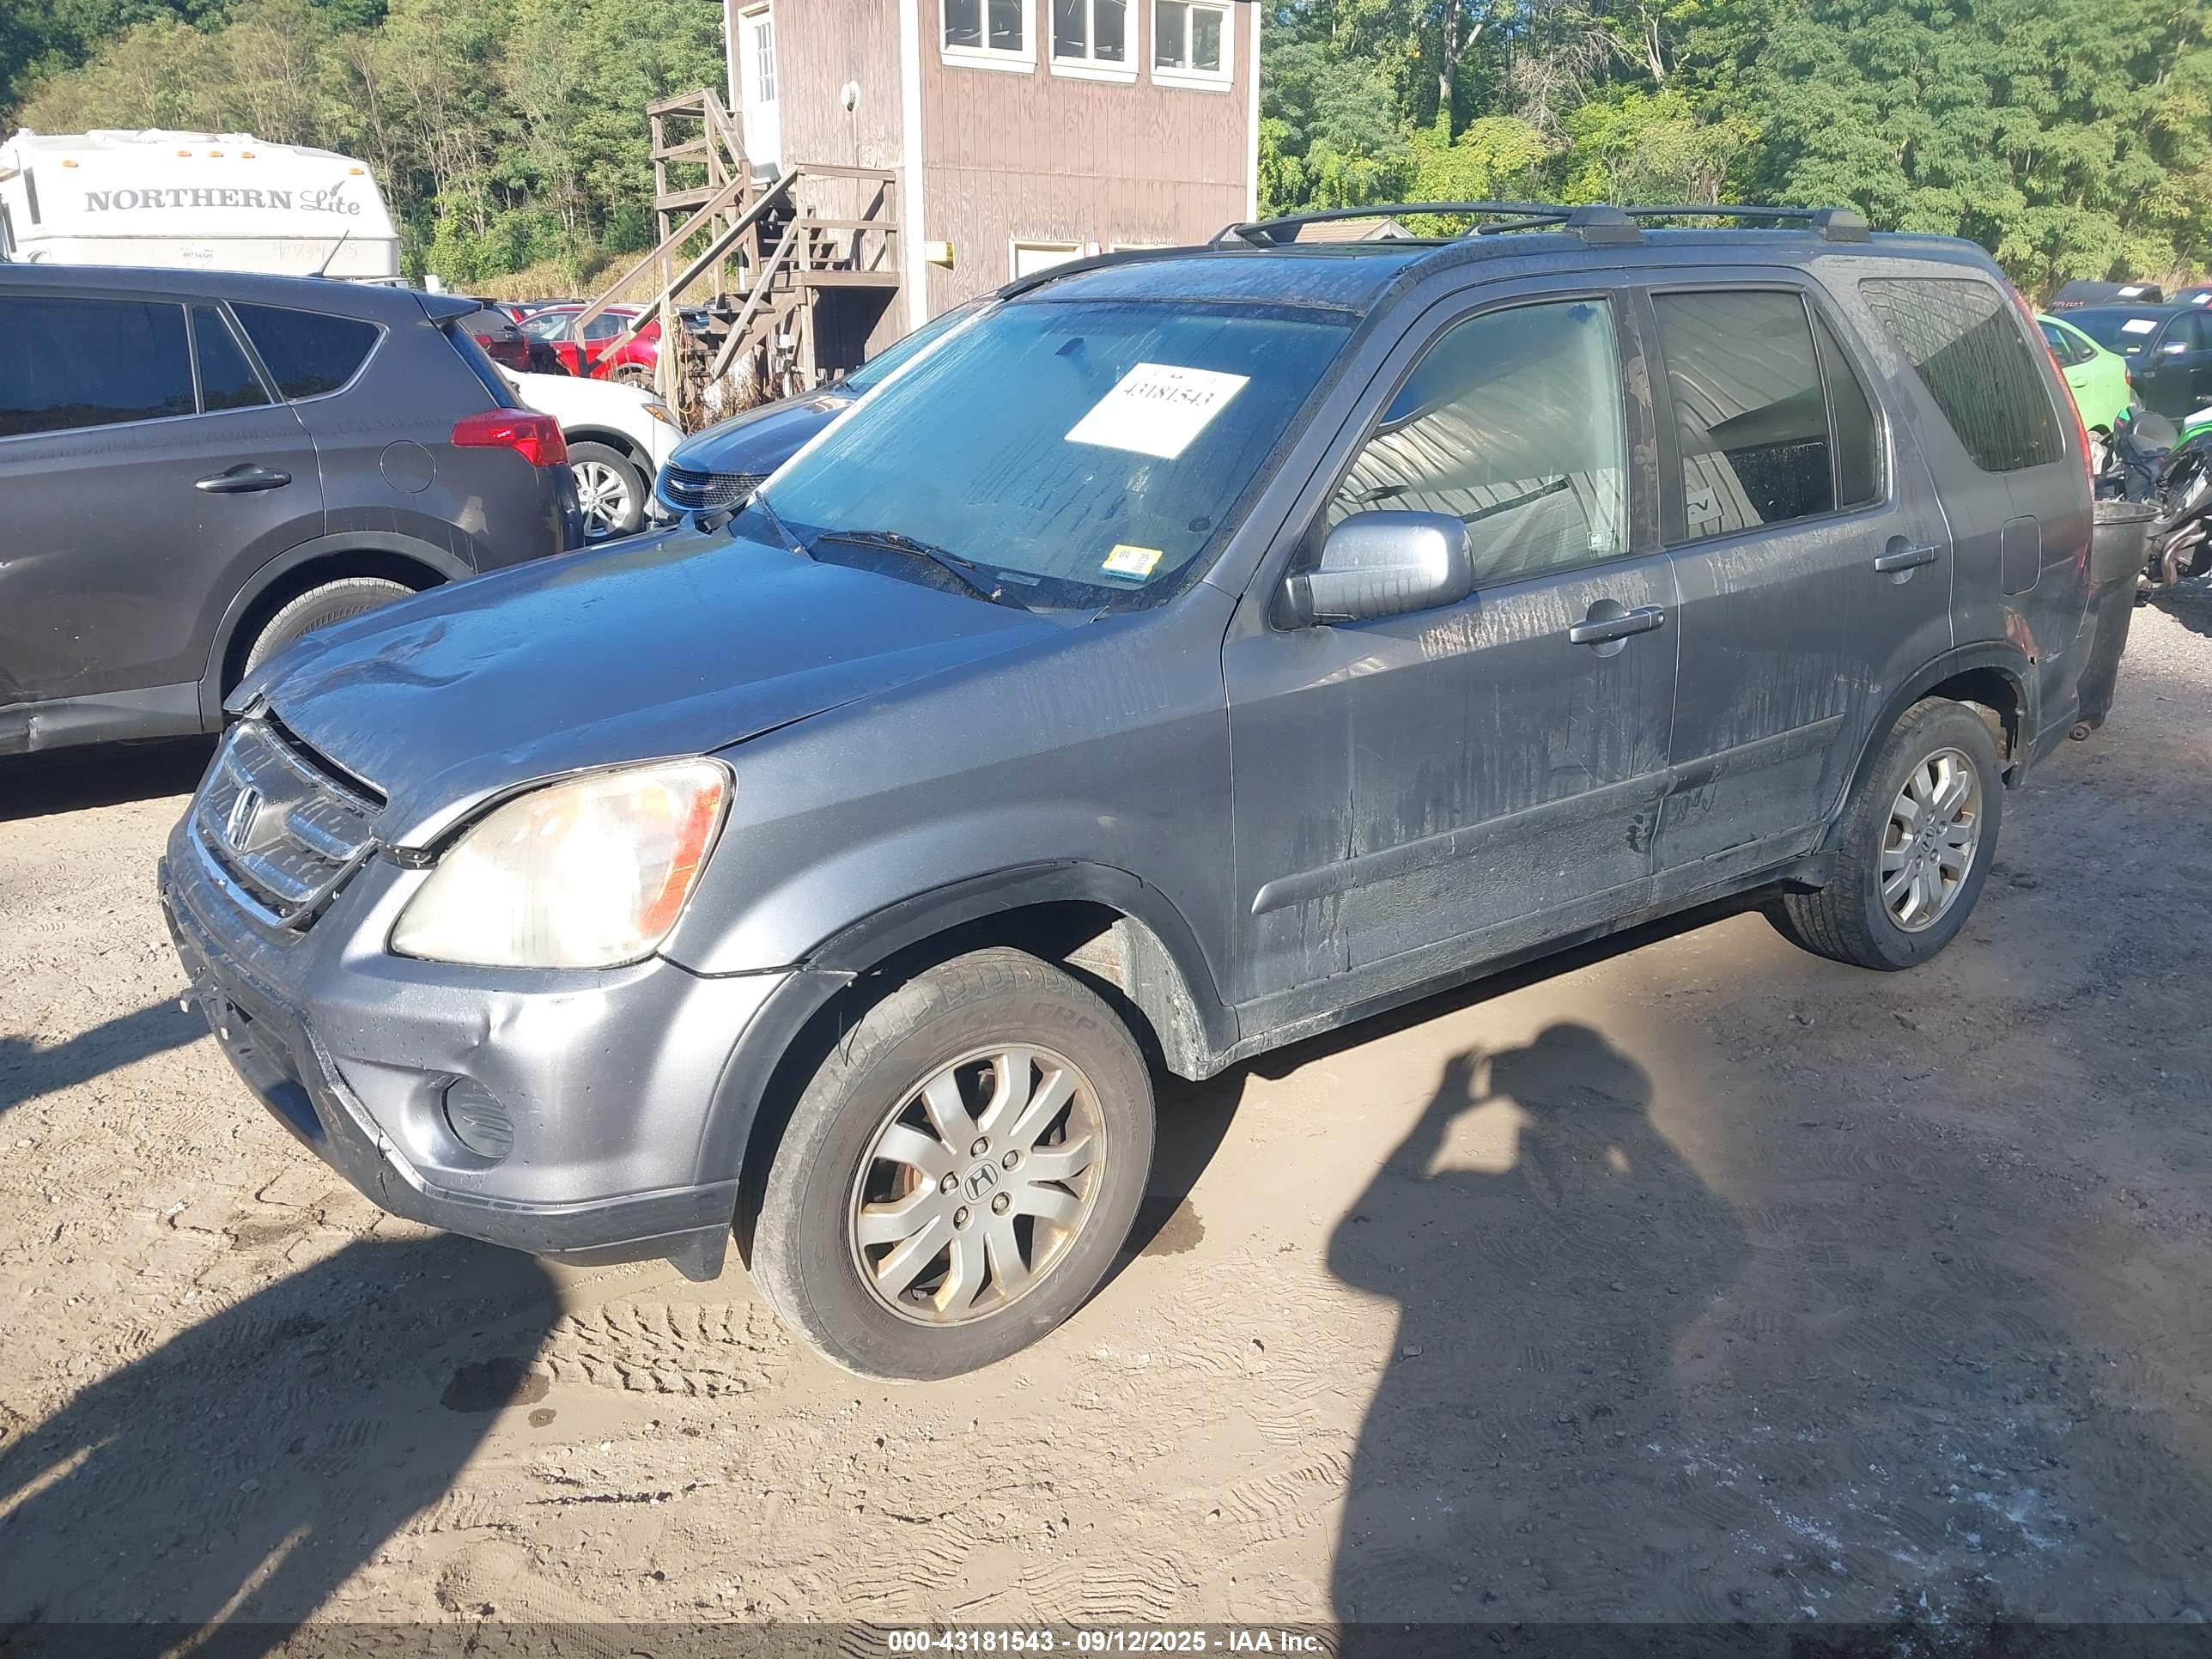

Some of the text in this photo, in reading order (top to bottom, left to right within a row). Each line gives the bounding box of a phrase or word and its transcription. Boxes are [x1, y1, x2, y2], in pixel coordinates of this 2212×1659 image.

[84, 182, 361, 215] NORTHERN Lite
[1124, 383, 1215, 406] 43181543
